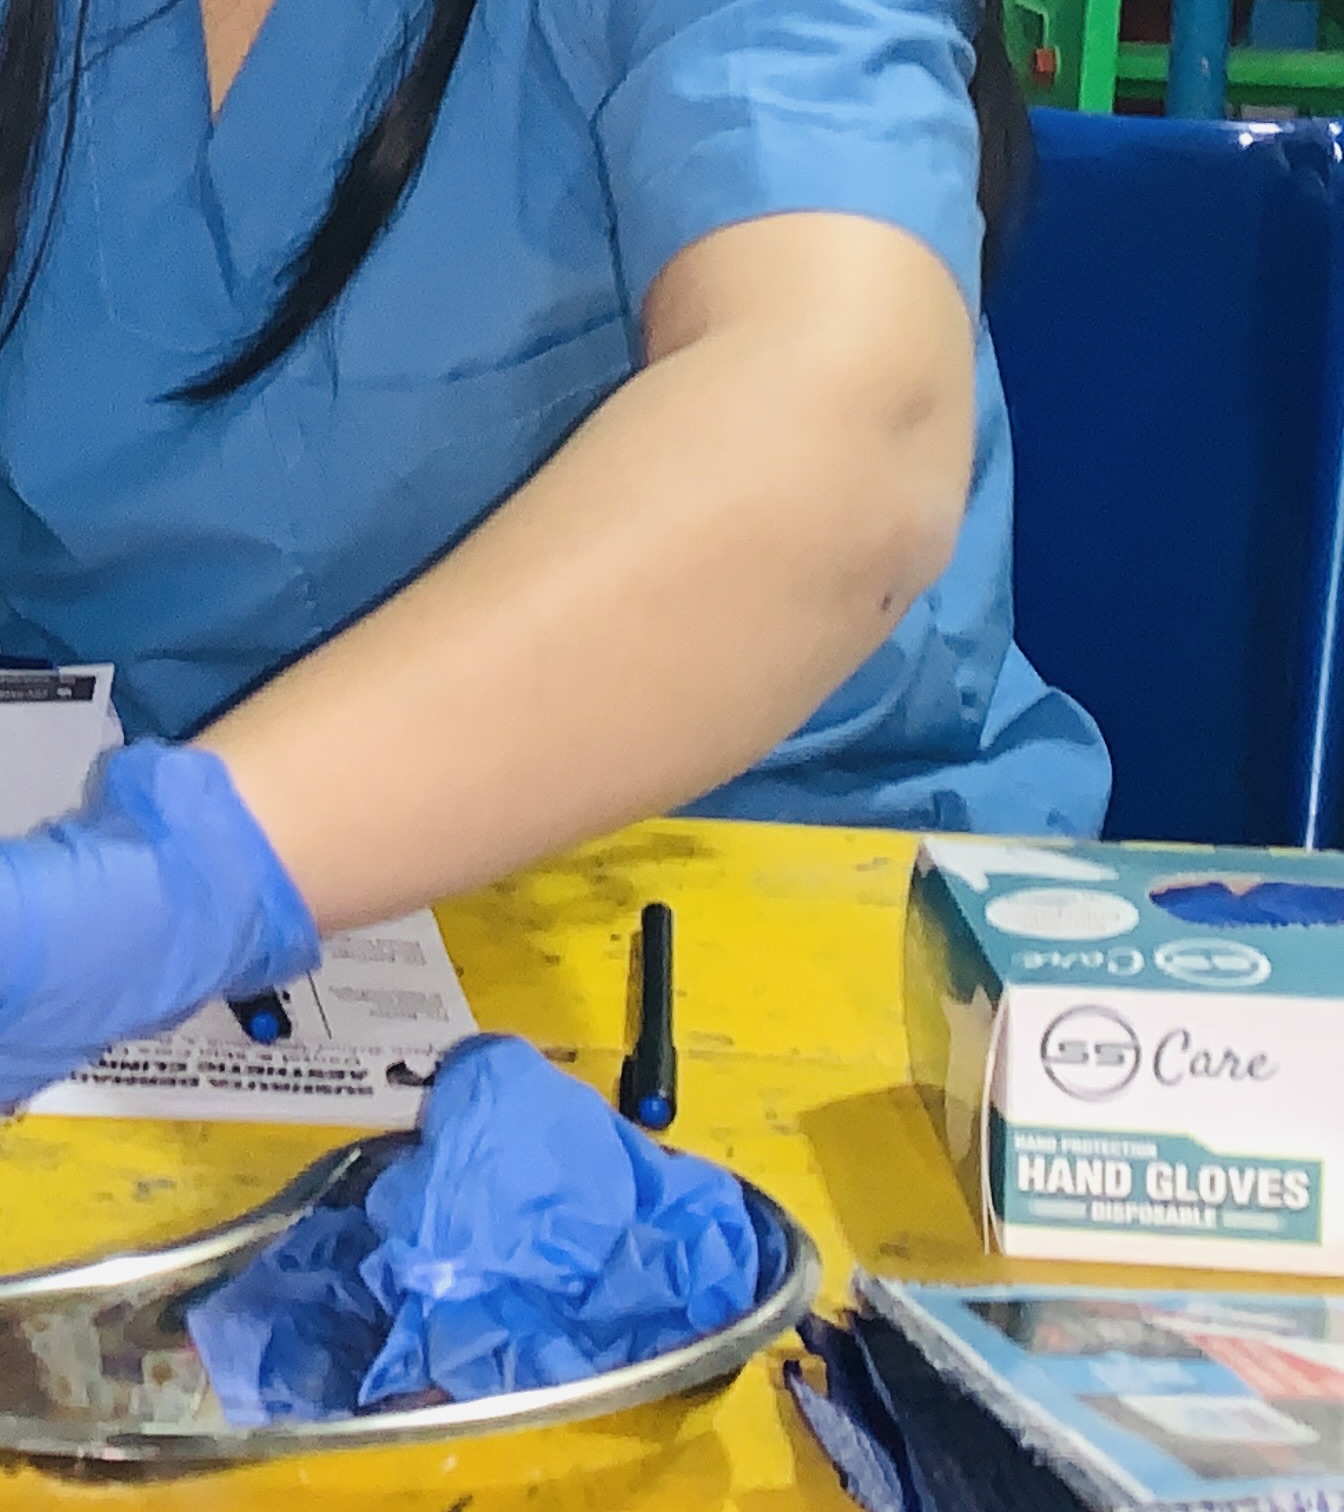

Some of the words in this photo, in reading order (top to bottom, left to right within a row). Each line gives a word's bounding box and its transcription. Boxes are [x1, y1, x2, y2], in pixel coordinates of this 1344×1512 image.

[1153, 1026, 1279, 1087] Care
[1017, 1154, 1132, 1198] HAND
[1145, 1160, 1310, 1211] GLOVES
